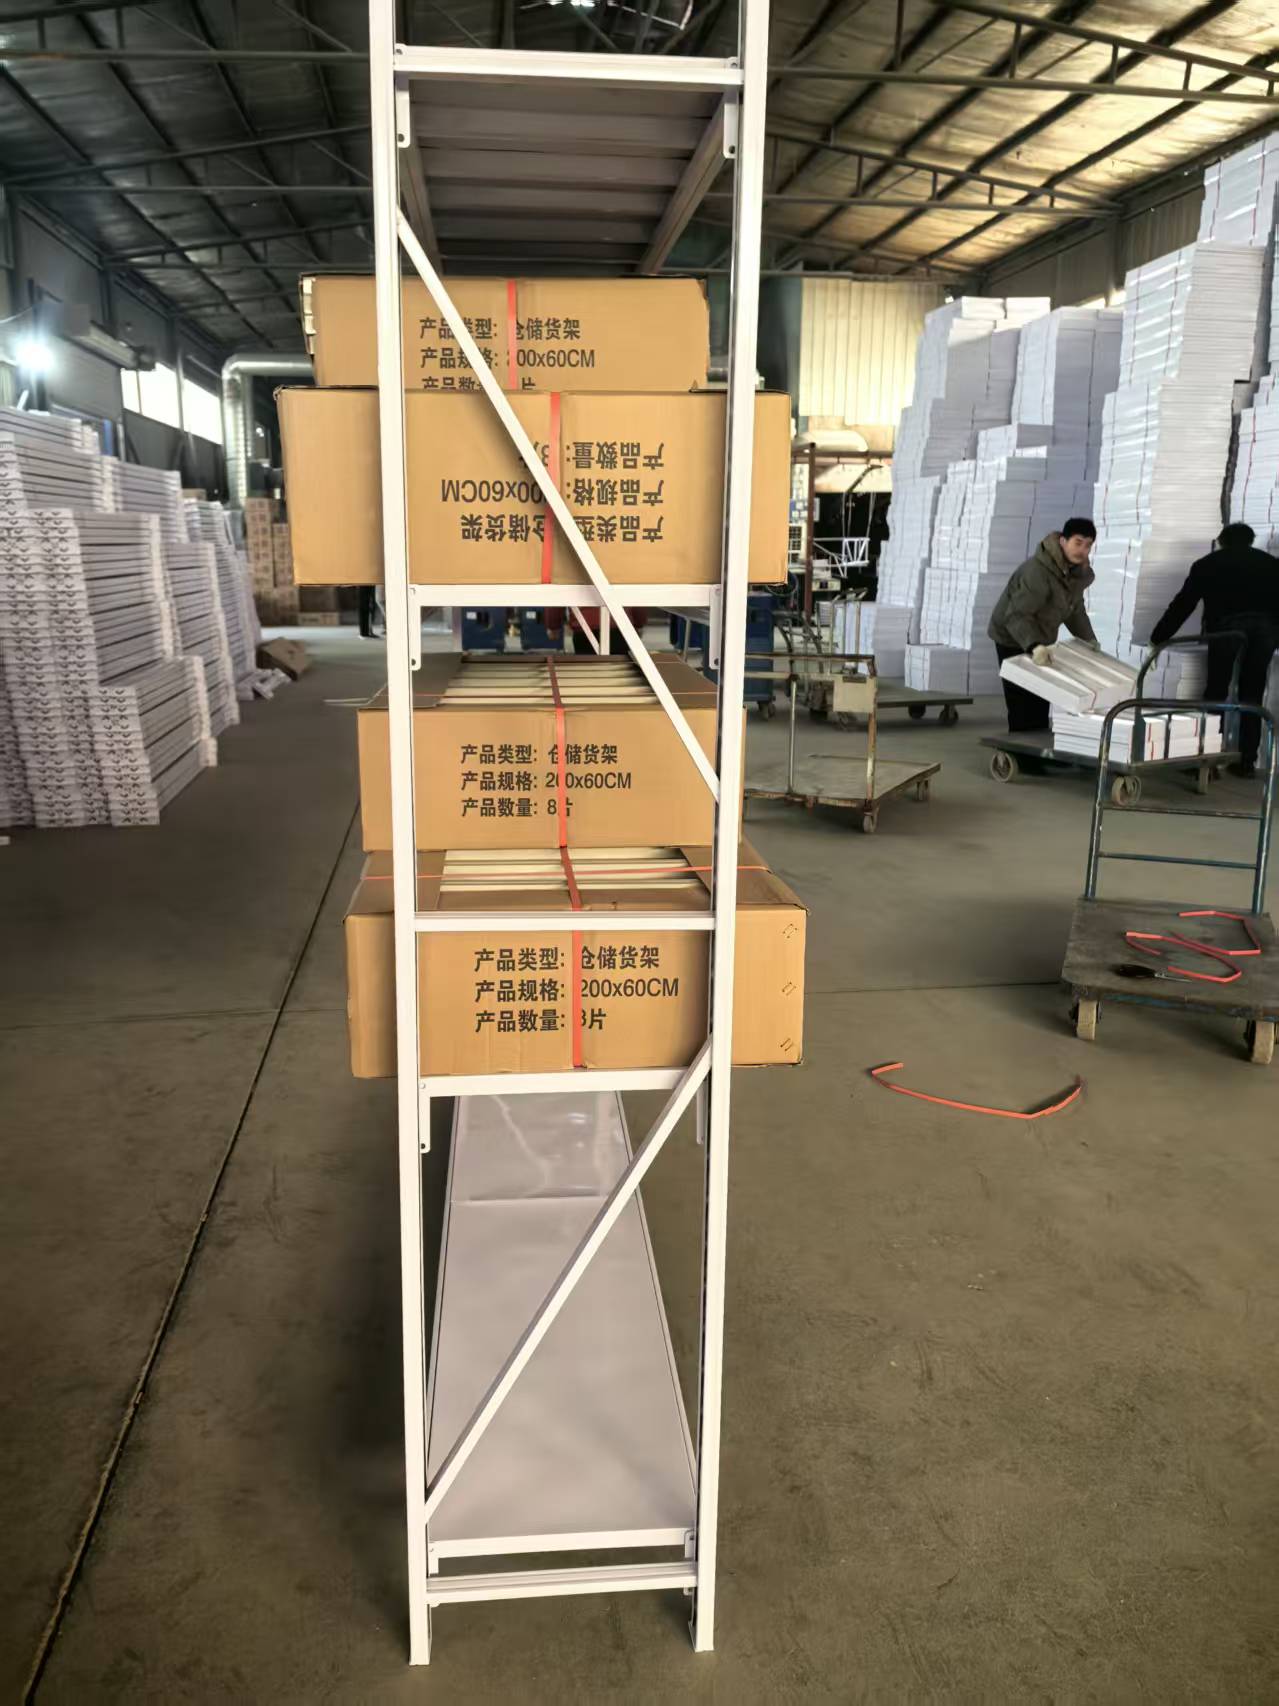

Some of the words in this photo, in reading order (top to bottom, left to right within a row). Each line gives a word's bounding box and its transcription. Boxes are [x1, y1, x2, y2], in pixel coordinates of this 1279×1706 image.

[507, 349, 595, 368] 00x60CM
[566, 441, 664, 470] 产品数量:
[441, 479, 547, 503] 00x60CM
[566, 478, 664, 506] 产品规格:
[461, 744, 537, 765] 产品类型:
[461, 771, 538, 792] 产品规格:
[545, 772, 632, 789] 20x60CM
[462, 797, 538, 817] 产品数量:
[474, 946, 565, 972] 产品类型:
[581, 945, 660, 970] 仓储货架
[475, 978, 565, 1003] 产品规格:
[475, 1009, 565, 1033] 产品数量:
